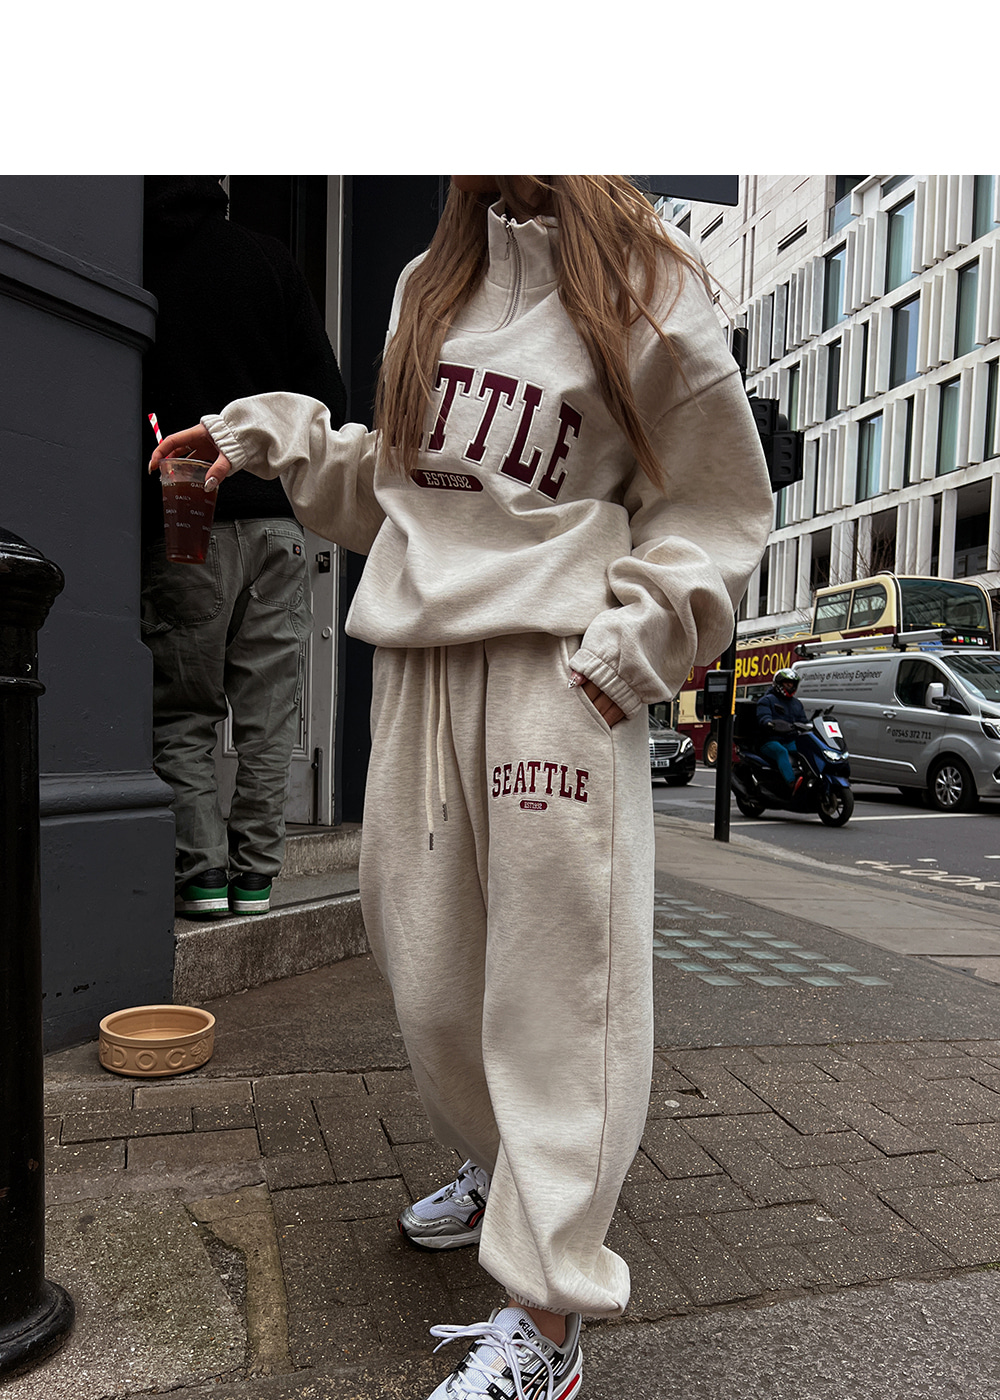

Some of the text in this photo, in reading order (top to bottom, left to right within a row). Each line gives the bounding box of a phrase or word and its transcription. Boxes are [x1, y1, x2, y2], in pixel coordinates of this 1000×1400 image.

[425, 360, 585, 503] TTLE
[422, 471, 472, 489] EST1992
[716, 651, 791, 678] BUS.COM
[832, 671, 855, 682] Heating
[855, 669, 883, 682] Engineer
[828, 724, 838, 734] L
[909, 730, 921, 739] 372
[921, 730, 932, 740] 711
[491, 761, 589, 803] SEATTLE
